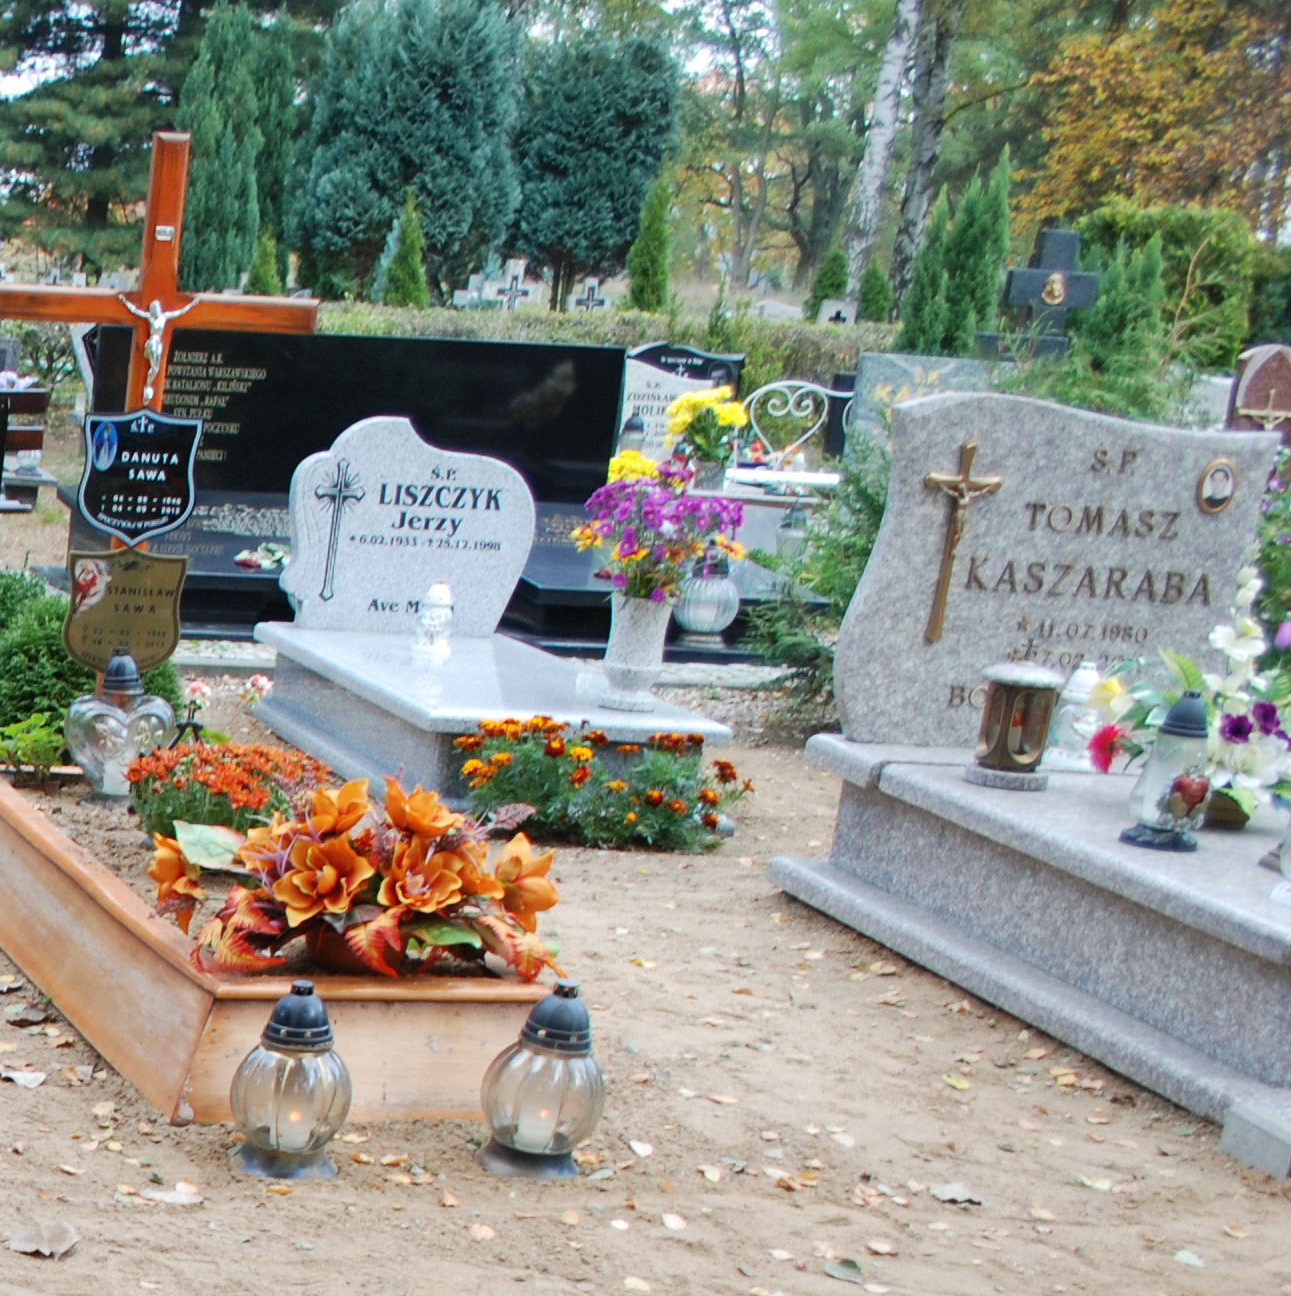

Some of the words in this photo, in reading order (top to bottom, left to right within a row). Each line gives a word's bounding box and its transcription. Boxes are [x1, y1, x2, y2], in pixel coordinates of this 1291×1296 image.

[121, 451, 179, 465] DANUTA
[128, 468, 166, 481] SAWA
[378, 482, 504, 512] LISZCZYK
[390, 511, 463, 538] Jerzy
[1025, 502, 1182, 542] TOMASZ
[964, 556, 1213, 606] KASZARABA
[107, 586, 176, 599] STANISŁAW
[114, 604, 156, 614] SAWA
[367, 598, 399, 614] Ave
